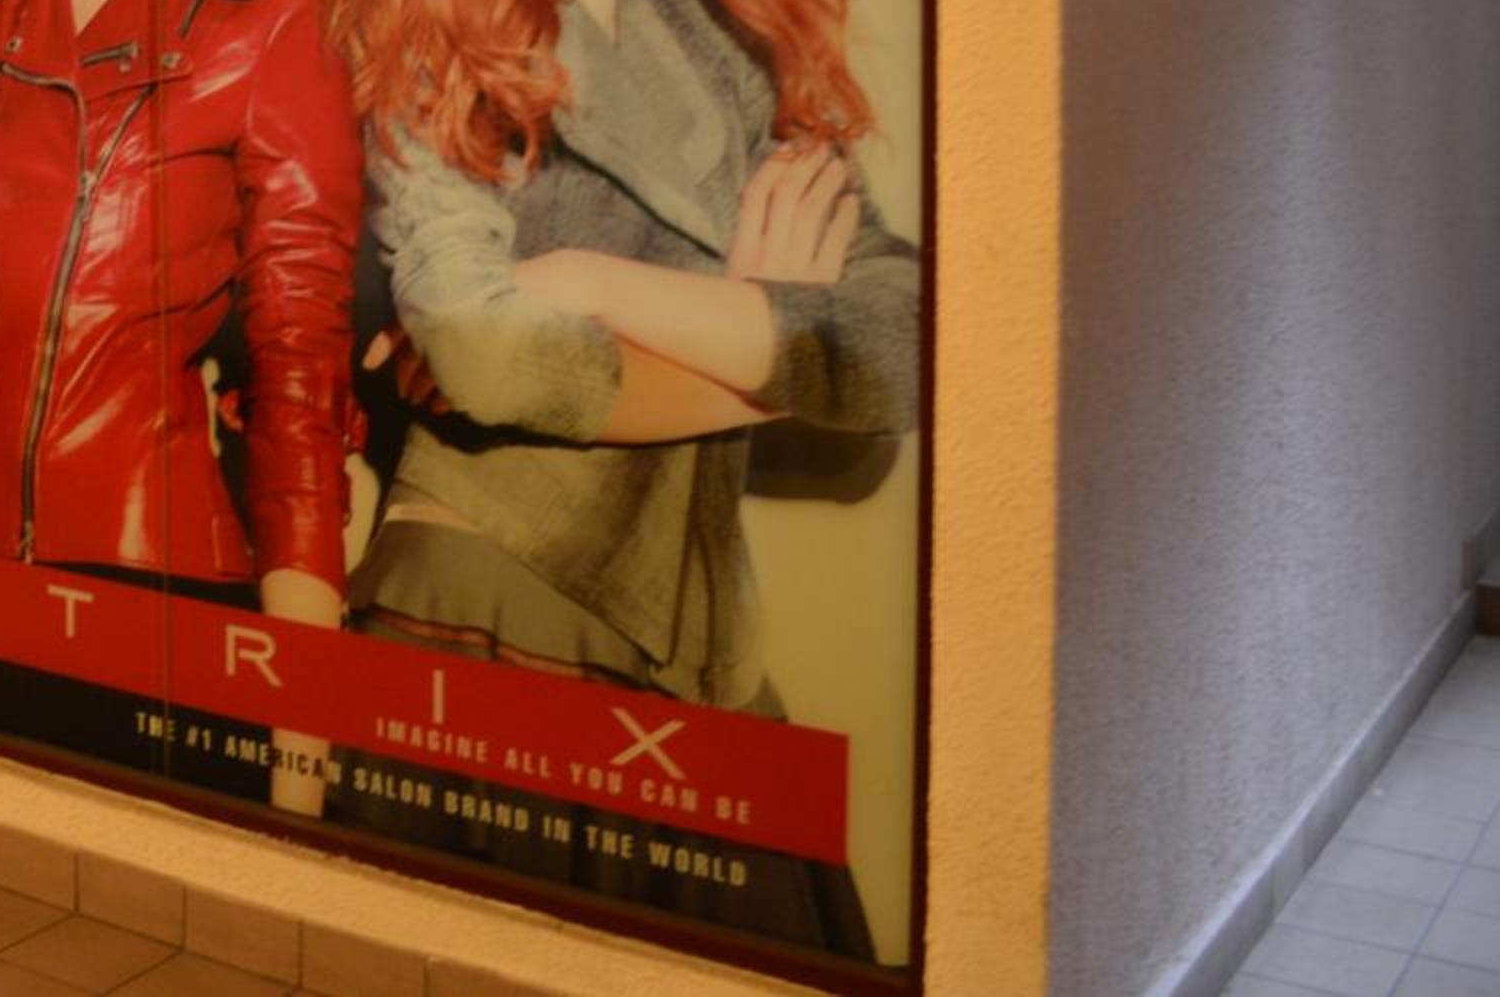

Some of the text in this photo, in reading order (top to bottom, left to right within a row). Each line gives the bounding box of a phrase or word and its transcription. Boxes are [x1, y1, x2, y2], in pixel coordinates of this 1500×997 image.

[135, 711, 746, 887] THE #1 AMERICAN SALON BRAND IN THE WORLD
[376, 716, 751, 825] IMAGINE ALL YOU CAN BE
